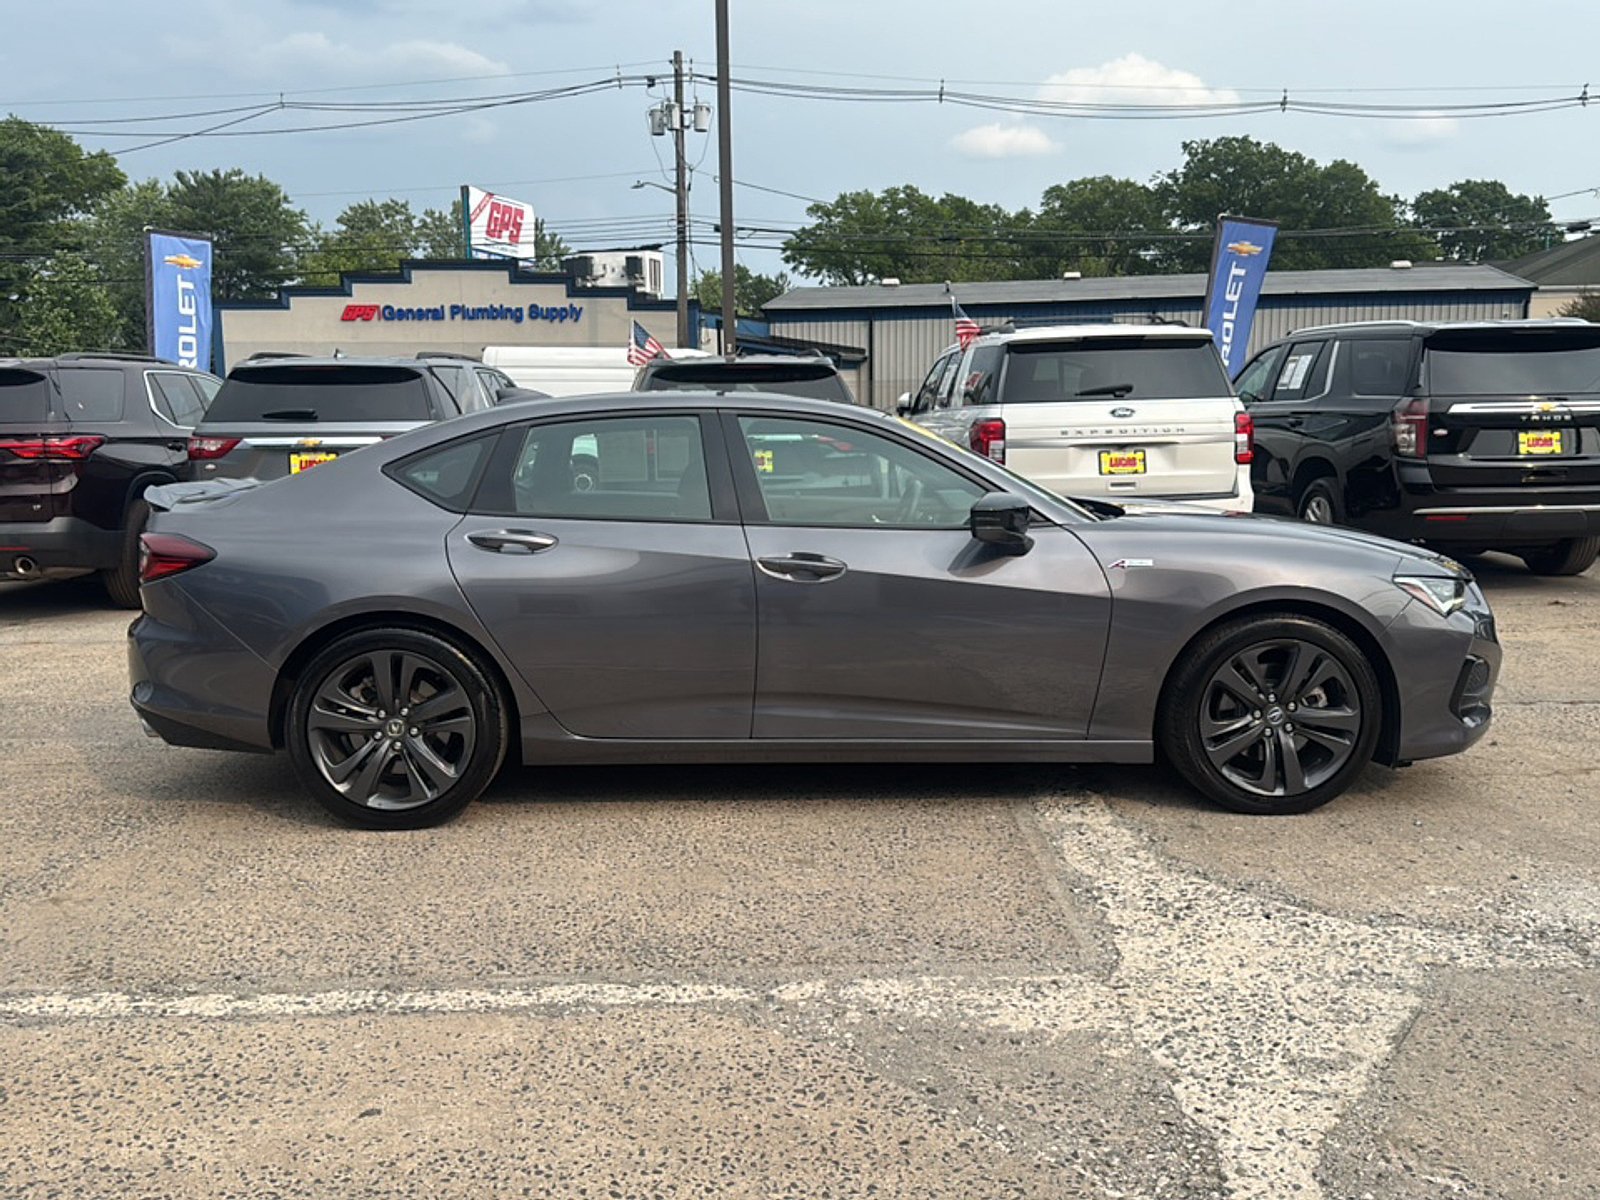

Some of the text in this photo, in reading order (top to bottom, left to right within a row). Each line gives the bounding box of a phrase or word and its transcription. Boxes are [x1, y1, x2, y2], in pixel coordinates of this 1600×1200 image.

[486, 202, 524, 244] GPS
[341, 303, 583, 324] GPS General Plumbing Supply
[1060, 427, 1185, 436] EXPEDITION
[1526, 436, 1554, 448] LUCAS
[1109, 456, 1138, 468] LUCAS
